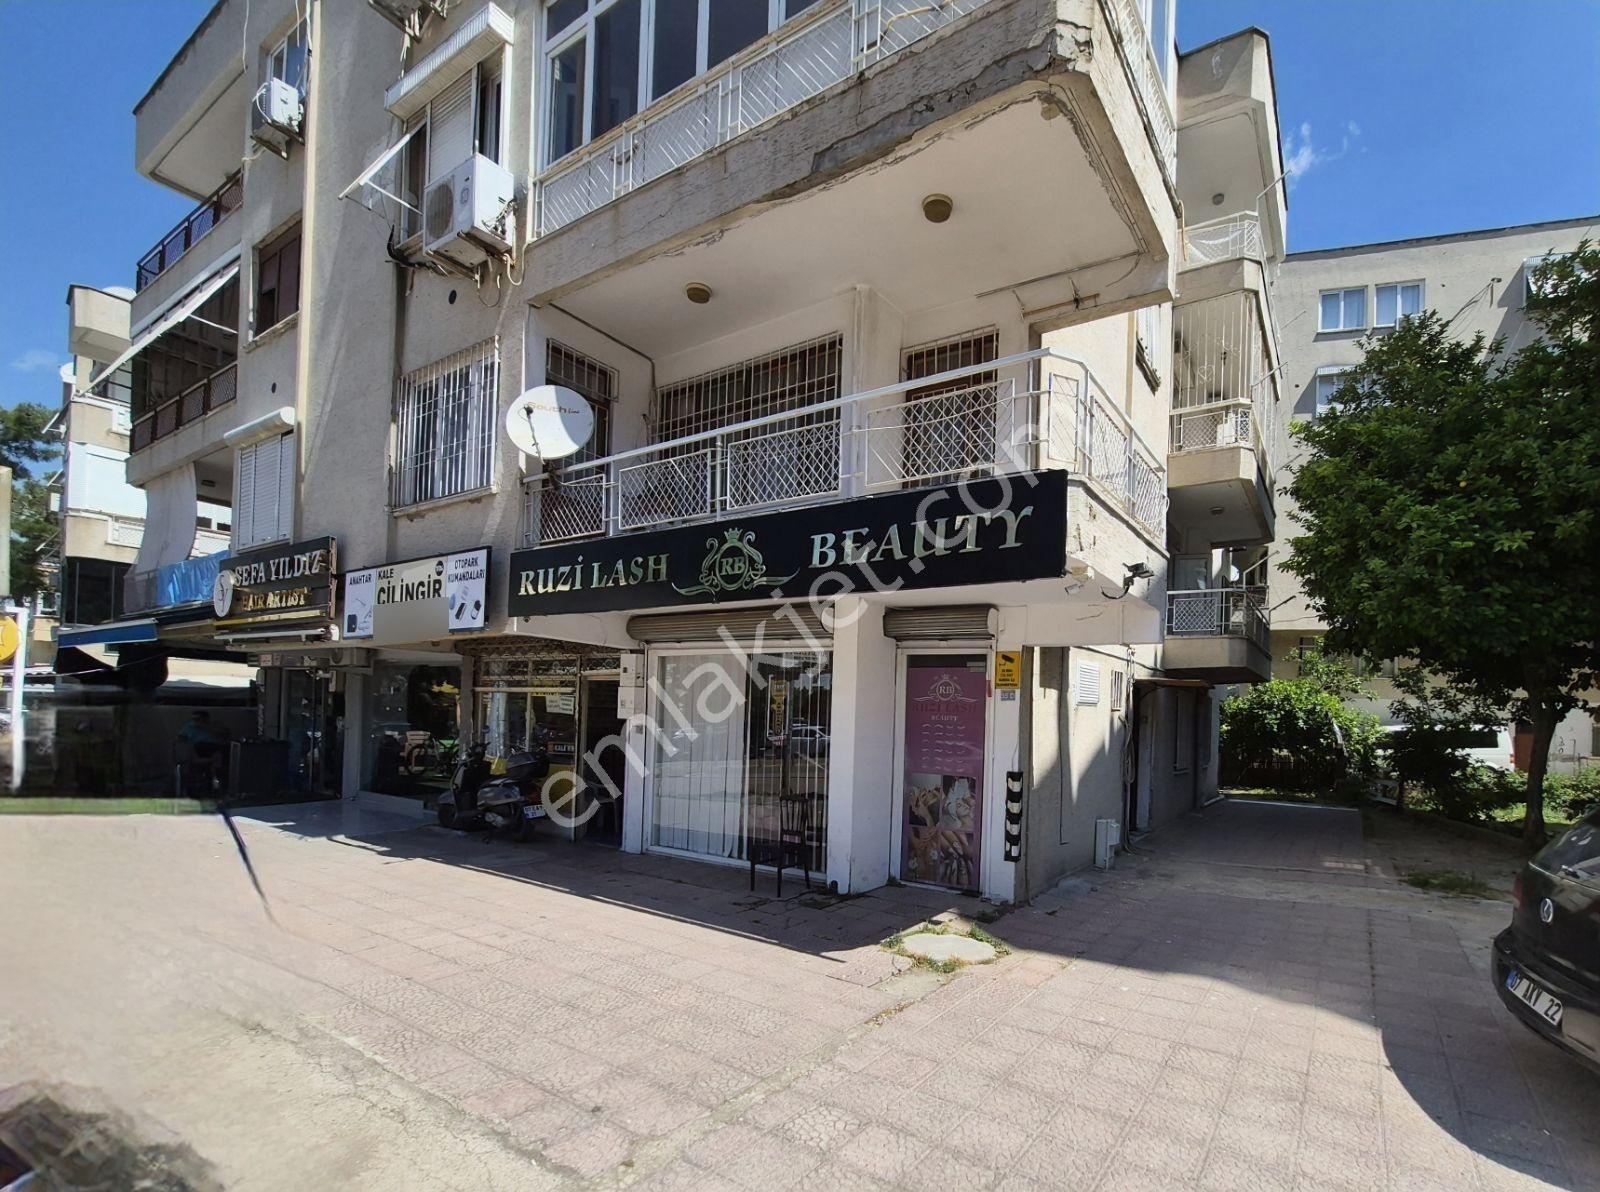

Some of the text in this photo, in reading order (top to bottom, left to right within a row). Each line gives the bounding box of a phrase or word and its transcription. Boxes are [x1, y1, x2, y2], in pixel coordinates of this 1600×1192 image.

[808, 505, 1034, 569] BEAUTY
[234, 549, 321, 586] SEFA YILDIZ
[378, 568, 394, 580] KALE
[455, 557, 479, 569] OTOPARK
[591, 553, 670, 589] LASH
[720, 556, 746, 576] RB
[349, 573, 372, 585] ANAHTAR
[266, 587, 307, 609] ARTIST
[1544, 998, 1562, 1021] 22
